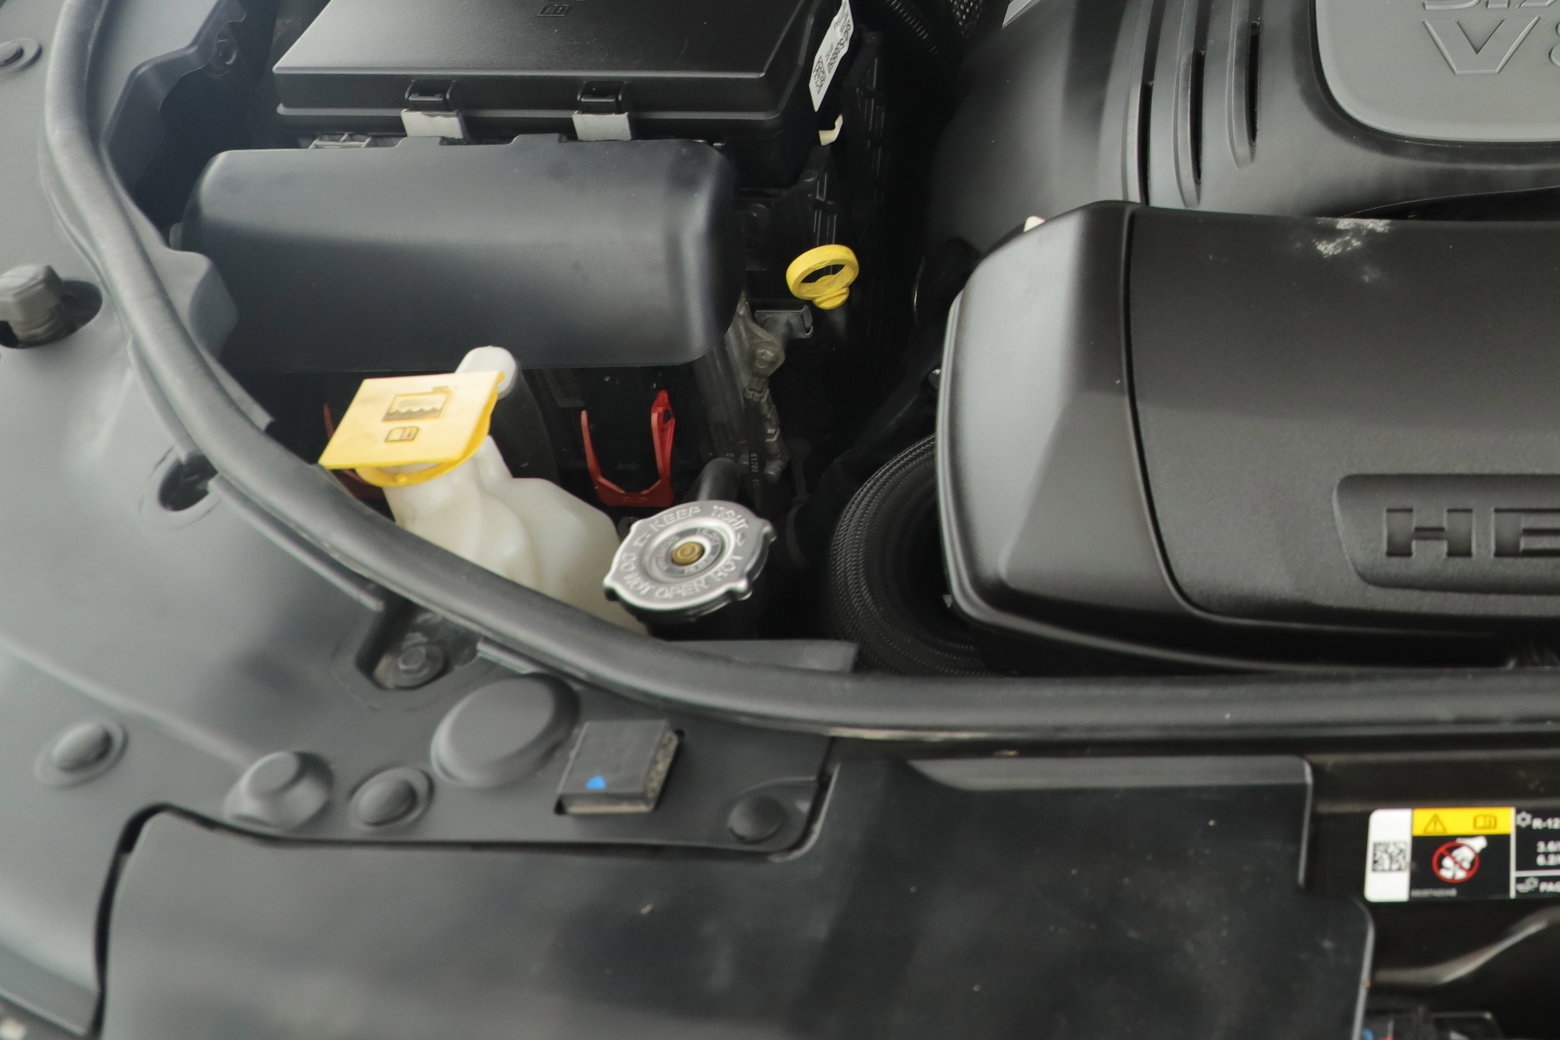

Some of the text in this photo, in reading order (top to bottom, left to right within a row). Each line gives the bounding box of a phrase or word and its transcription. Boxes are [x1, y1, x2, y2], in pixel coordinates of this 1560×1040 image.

[650, 505, 702, 531] KEEP
[619, 552, 634, 571] DO
[654, 578, 710, 600] OPEN
